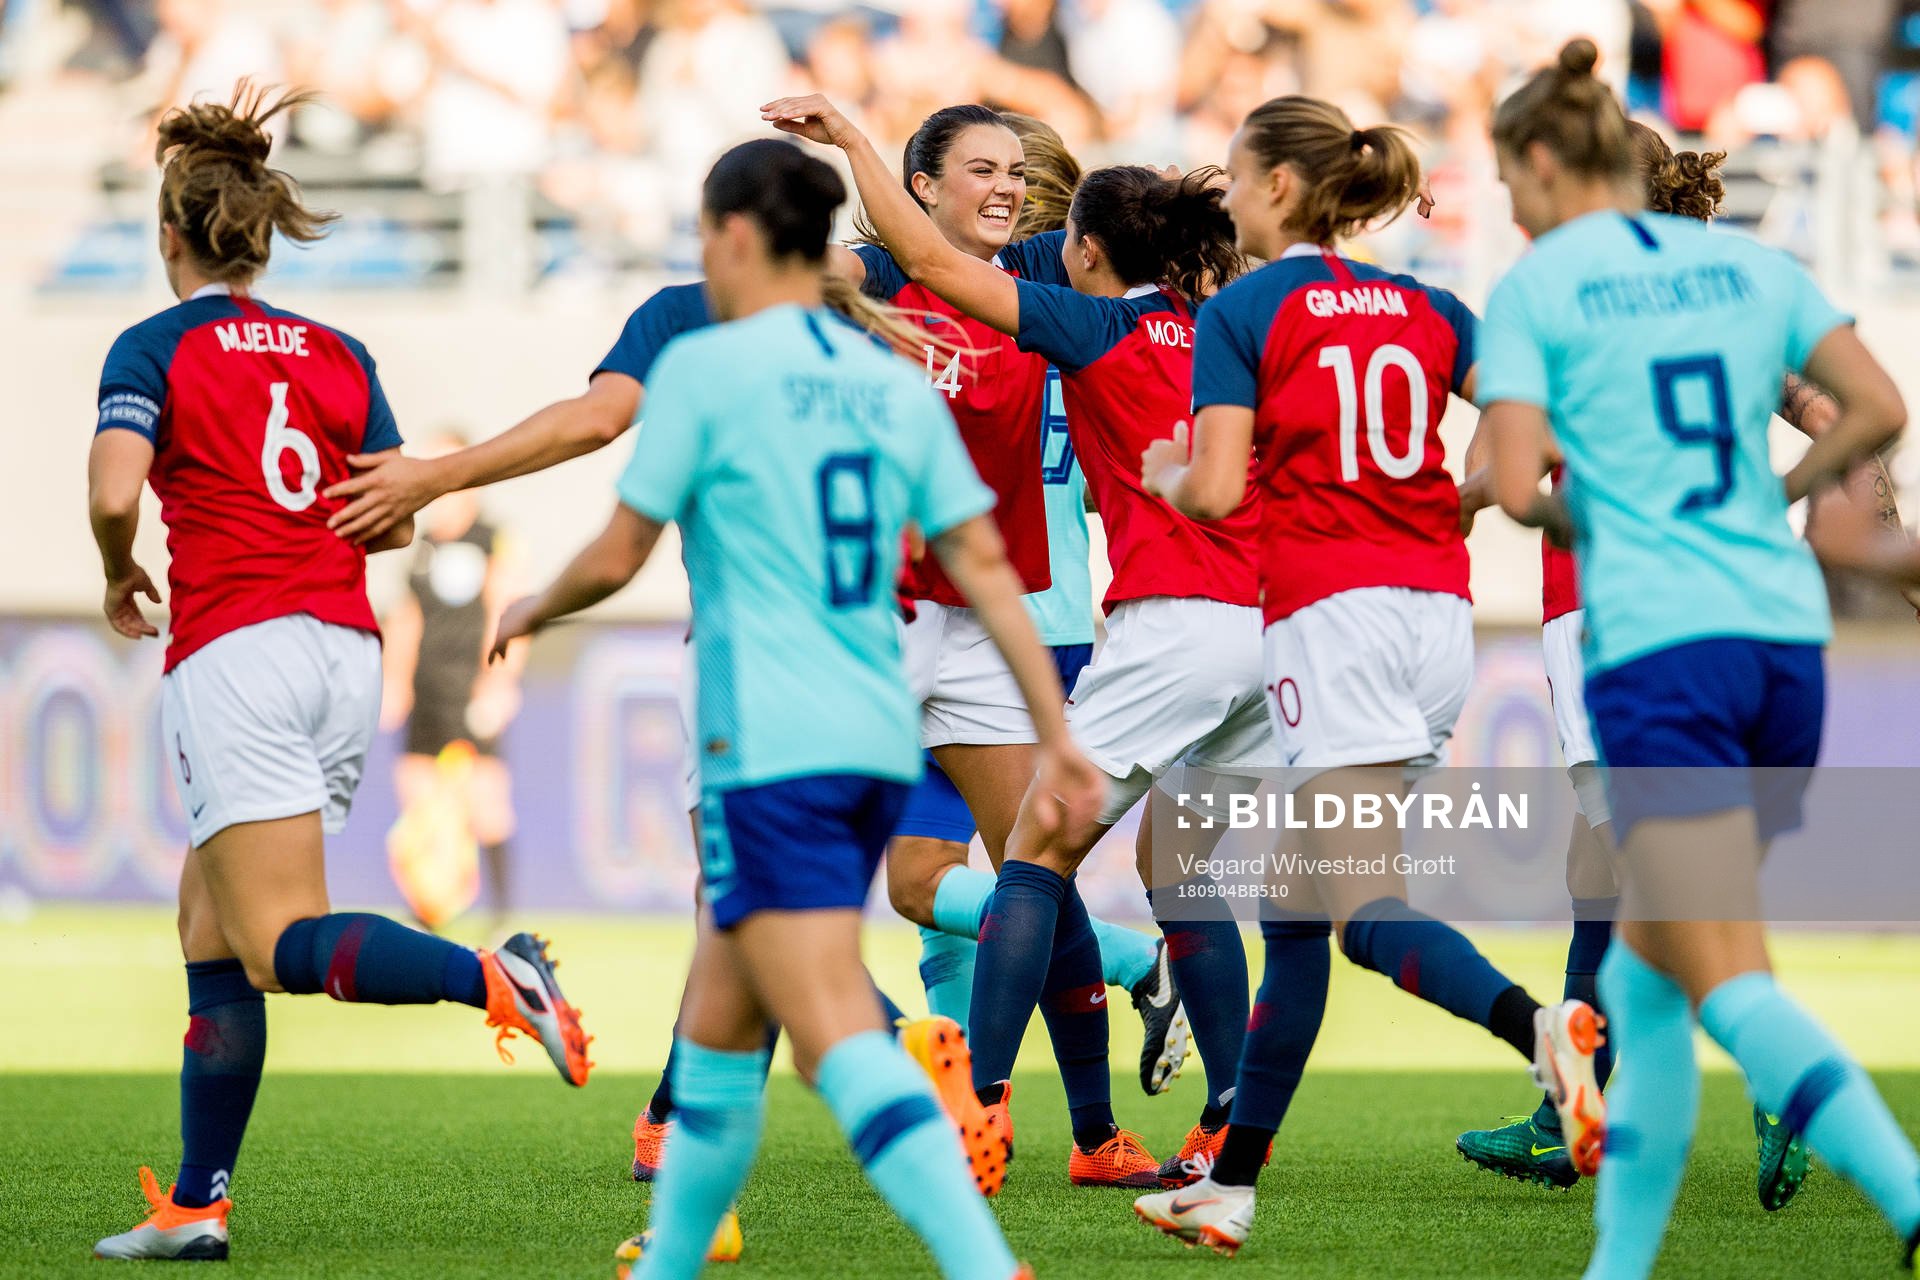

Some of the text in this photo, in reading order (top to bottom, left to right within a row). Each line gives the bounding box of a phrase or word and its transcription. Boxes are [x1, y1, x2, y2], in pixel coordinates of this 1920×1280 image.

[214, 321, 310, 357] MJELDE
[1305, 286, 1409, 317] GRAHAM
[922, 343, 963, 399] 14
[1317, 343, 1428, 483] 10
[1650, 352, 1738, 518] 9
[261, 381, 322, 512] 6
[816, 451, 880, 608] 8
